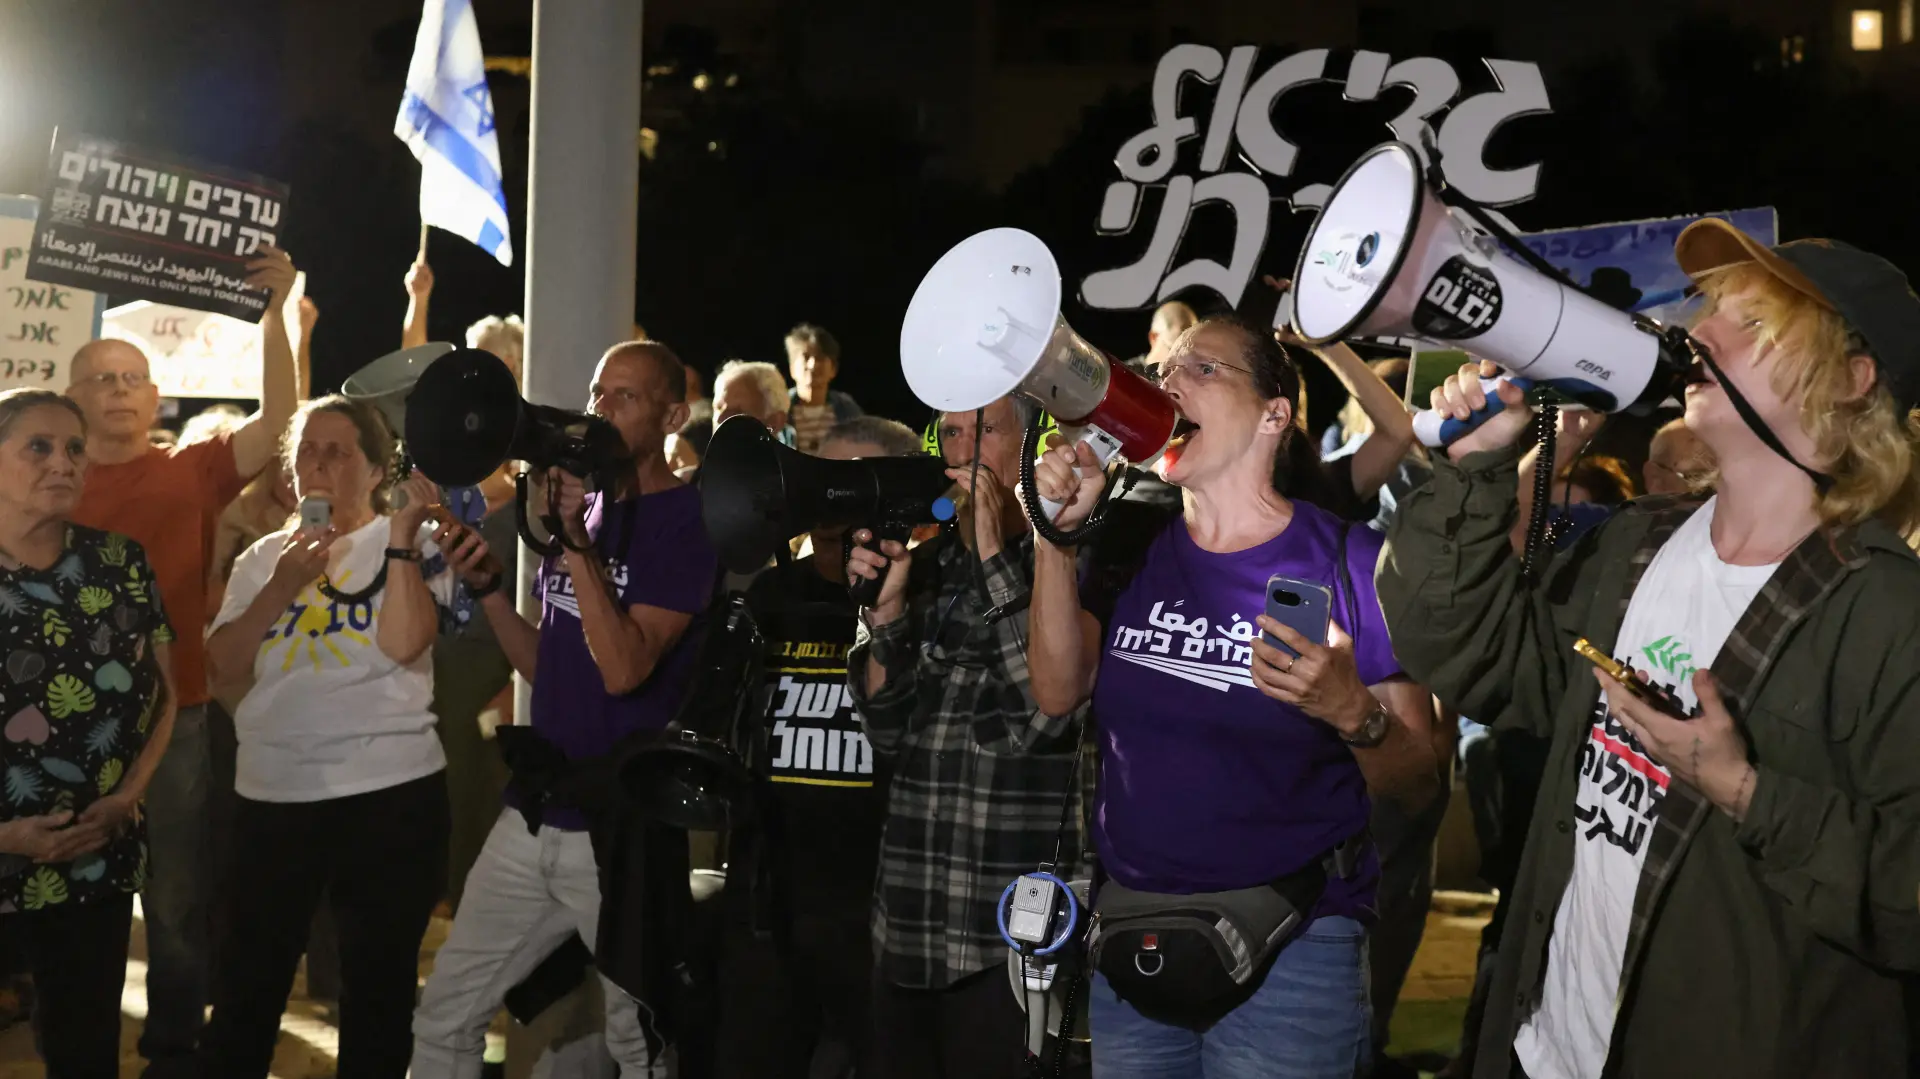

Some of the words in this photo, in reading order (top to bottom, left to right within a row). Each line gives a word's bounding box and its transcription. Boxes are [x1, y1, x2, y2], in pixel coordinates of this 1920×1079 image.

[59, 150, 179, 204] ויהודים
[95, 194, 172, 237] ננצח
[184, 179, 281, 228] ערבים
[178, 212, 232, 248] יחד
[234, 225, 277, 257] רק
[36, 255, 74, 271] ARABS
[74, 262, 100, 276] AND
[101, 268, 130, 282] JEWS
[130, 274, 156, 288] WILL
[160, 280, 187, 293] ONLY
[188, 285, 212, 297] WIN
[213, 288, 265, 310] TOGETHER
[1575, 359, 1611, 381] COPA
[262, 598, 373, 641] 7.10
[1181, 636, 1254, 666] מדים
[771, 720, 874, 774] מוחל
